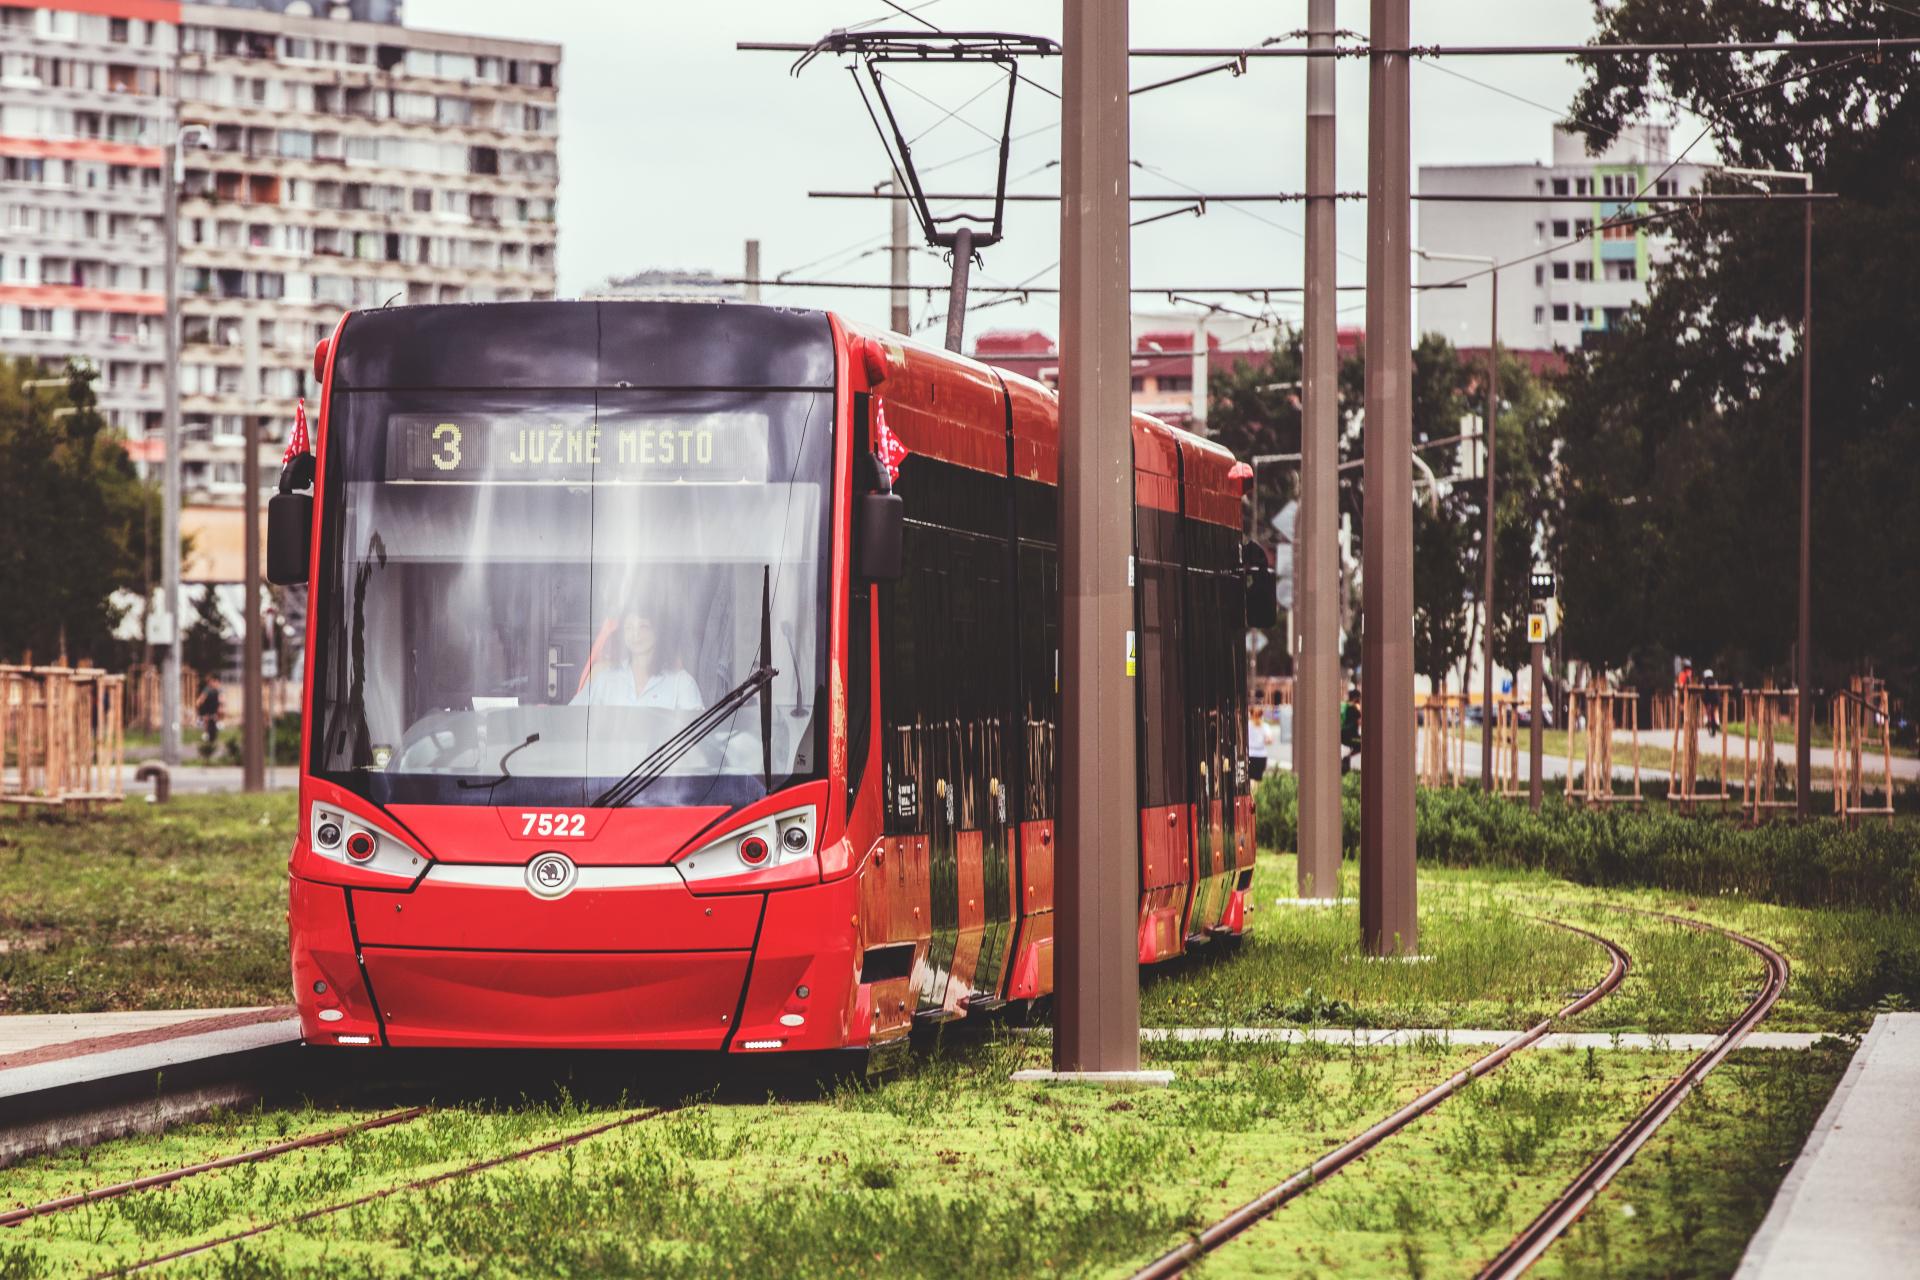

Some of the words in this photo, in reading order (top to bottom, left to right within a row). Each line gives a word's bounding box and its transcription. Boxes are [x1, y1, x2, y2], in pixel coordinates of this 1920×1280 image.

[432, 423, 462, 470] 3
[618, 429, 713, 464] MESTO
[521, 813, 586, 837] 7522
